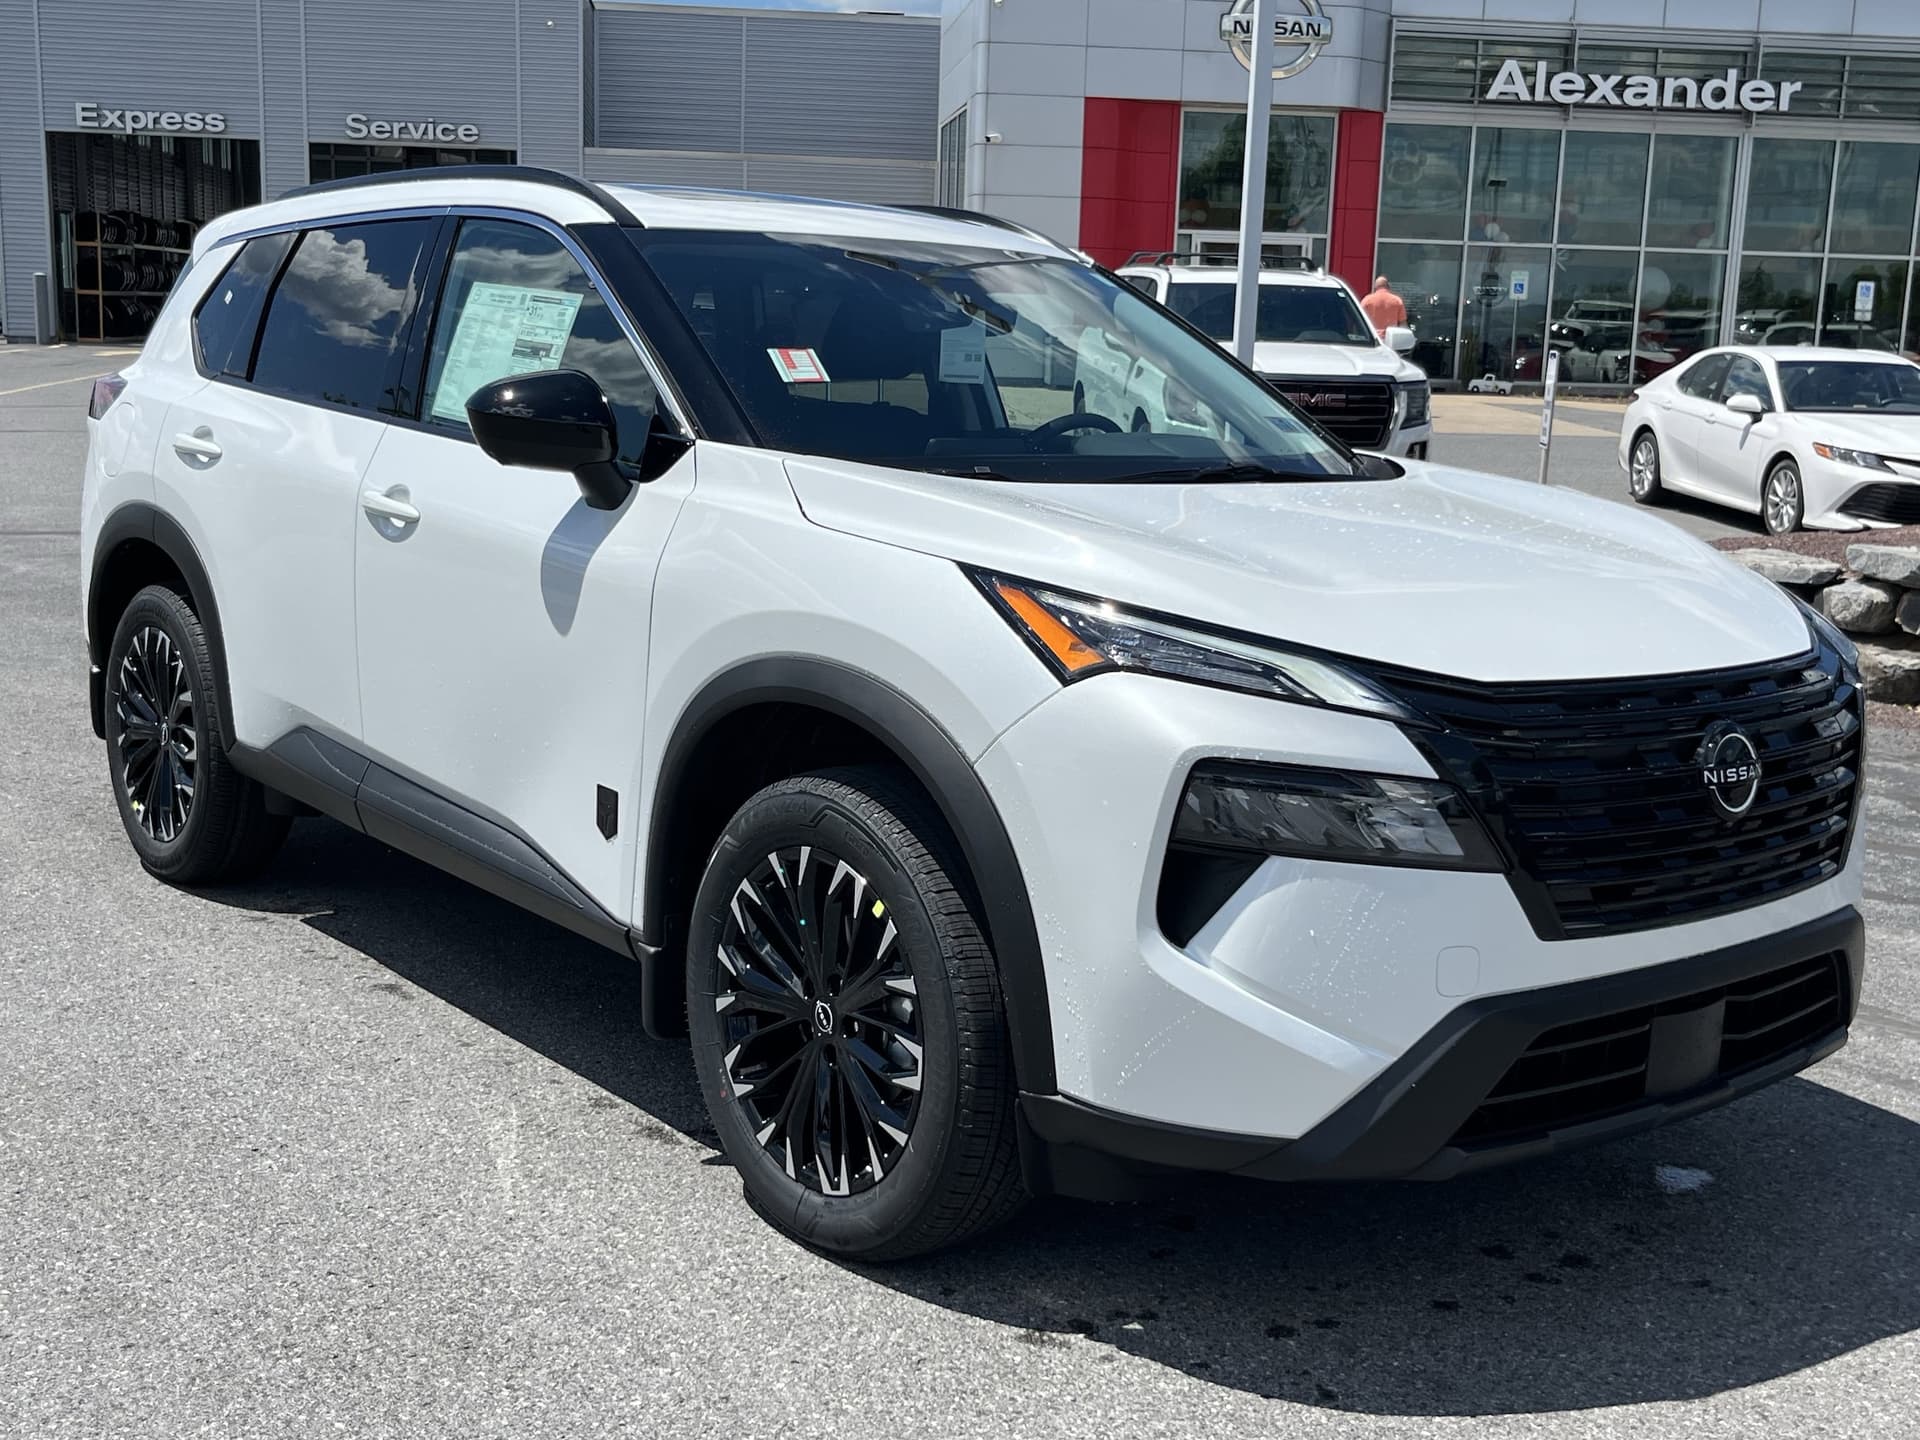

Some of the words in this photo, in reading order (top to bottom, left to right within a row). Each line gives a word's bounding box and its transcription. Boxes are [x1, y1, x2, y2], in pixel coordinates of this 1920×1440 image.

[1233, 20, 1321, 37] NSAN
[1485, 59, 1802, 112] Alexander
[75, 102, 226, 134] Express
[345, 113, 479, 143] Service
[1703, 763, 1762, 784] NISSAN
